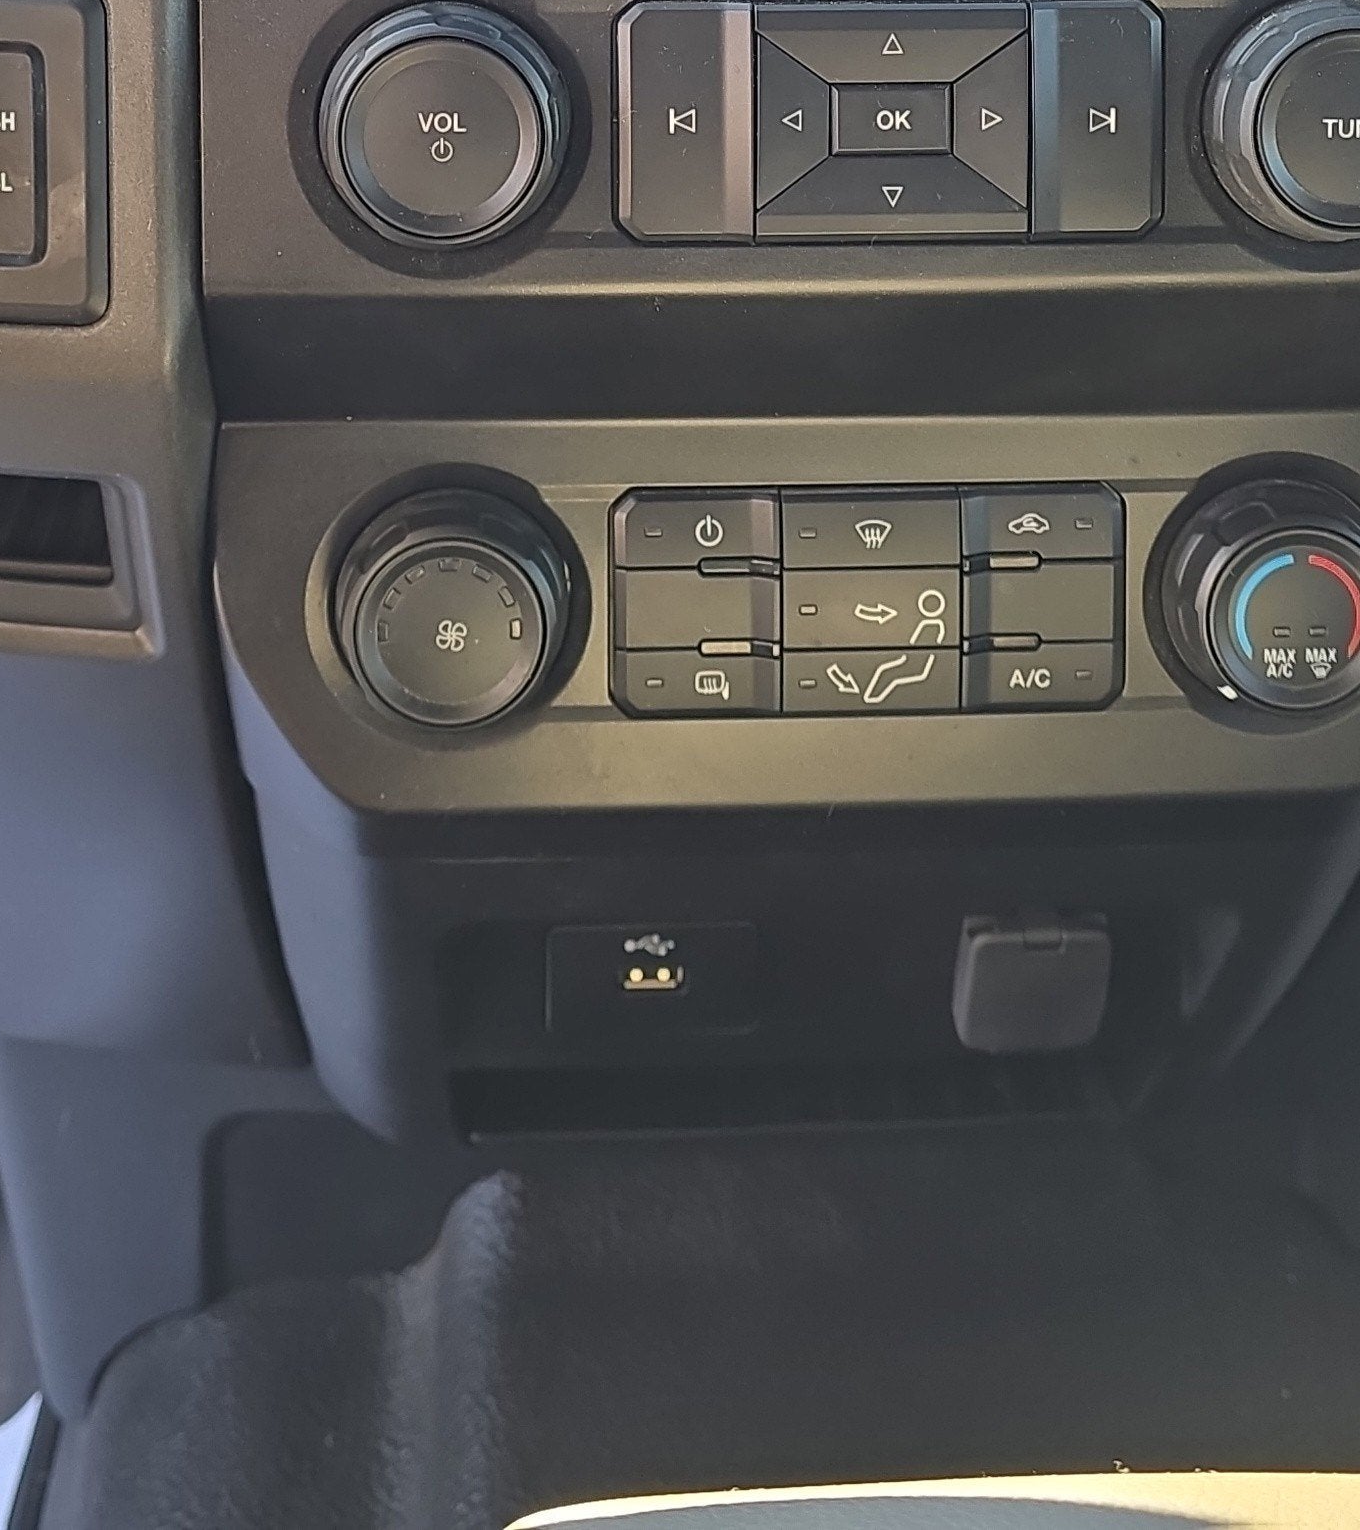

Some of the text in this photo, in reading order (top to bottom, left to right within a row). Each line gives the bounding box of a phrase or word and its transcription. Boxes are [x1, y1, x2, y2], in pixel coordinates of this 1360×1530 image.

[417, 112, 467, 133] VOL
[876, 109, 912, 130] OK
[1263, 648, 1297, 664] MAX
[1305, 647, 1338, 664] MAX
[1009, 668, 1051, 689] A/C
[1266, 662, 1294, 679] A/C
